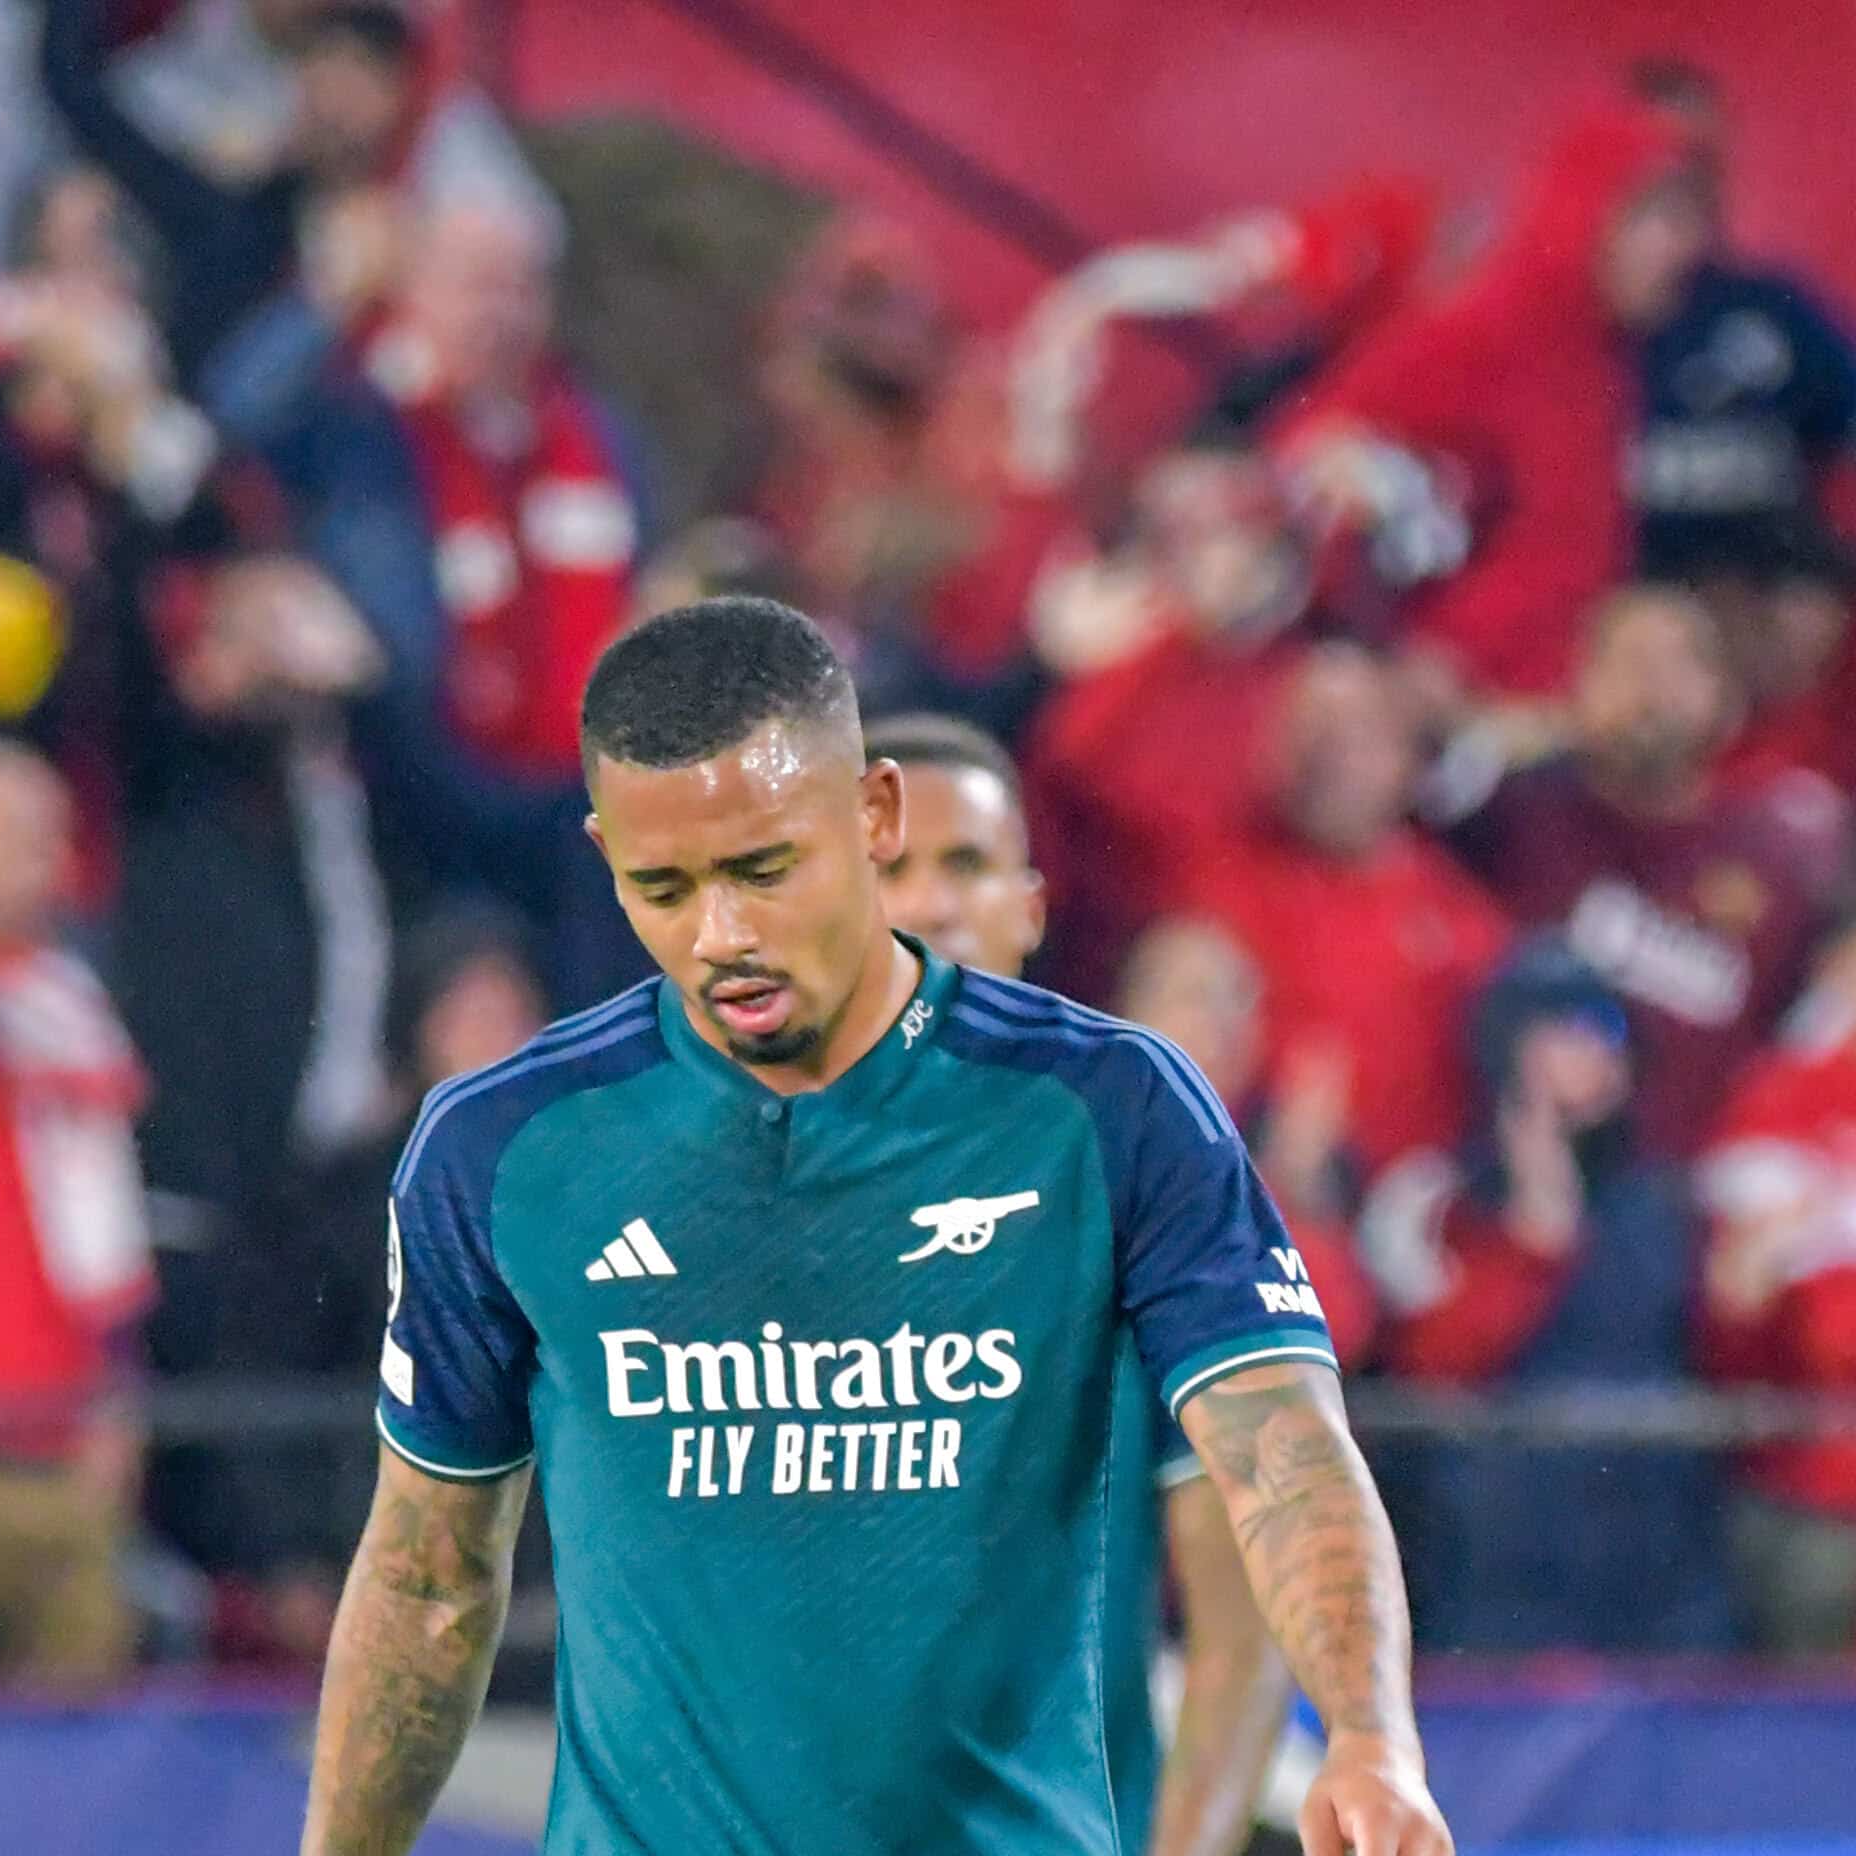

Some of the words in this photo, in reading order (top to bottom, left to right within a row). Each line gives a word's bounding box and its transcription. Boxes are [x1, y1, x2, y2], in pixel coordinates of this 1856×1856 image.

[598, 1320, 1023, 1418] Emirates
[667, 1425, 755, 1498] FLY
[771, 1418, 962, 1495] BETTER
